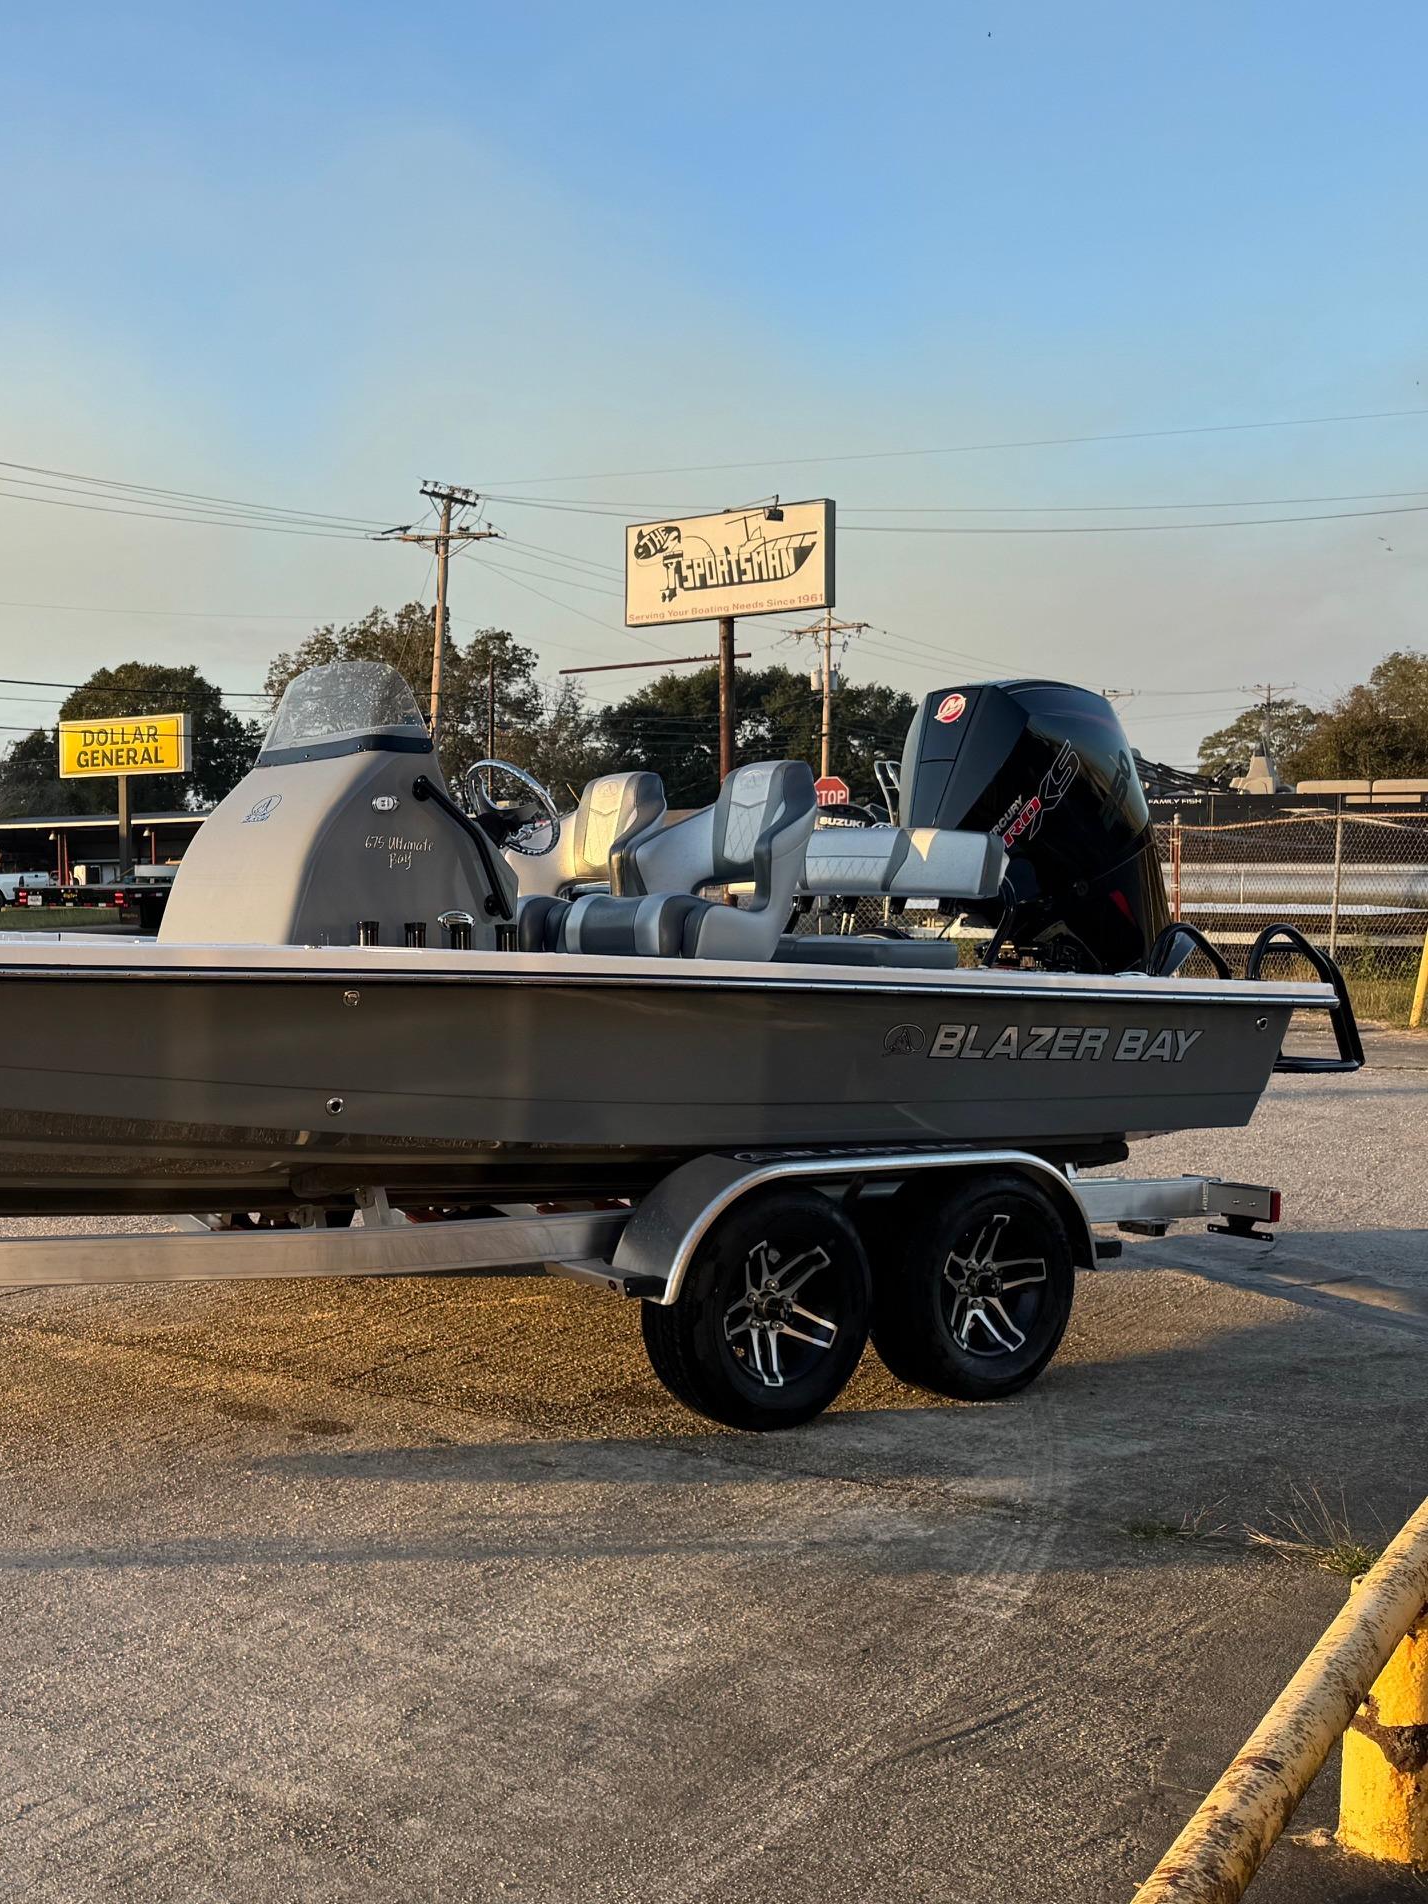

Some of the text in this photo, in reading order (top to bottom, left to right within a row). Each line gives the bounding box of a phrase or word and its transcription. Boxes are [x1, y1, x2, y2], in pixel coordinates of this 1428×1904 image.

[639, 527, 669, 556] THE
[680, 548, 796, 589] SPORTSMAN
[628, 593, 824, 622] Serving Your Boating Needs Since 1961
[81, 725, 159, 748] DOLLAR
[76, 746, 164, 769] GENERAL
[816, 790, 846, 804] TOP
[819, 816, 866, 829] SUZUKI
[989, 794, 1023, 837] RCURY
[365, 835, 385, 849] 675
[928, 1023, 1205, 1063] BLAZER BAY
